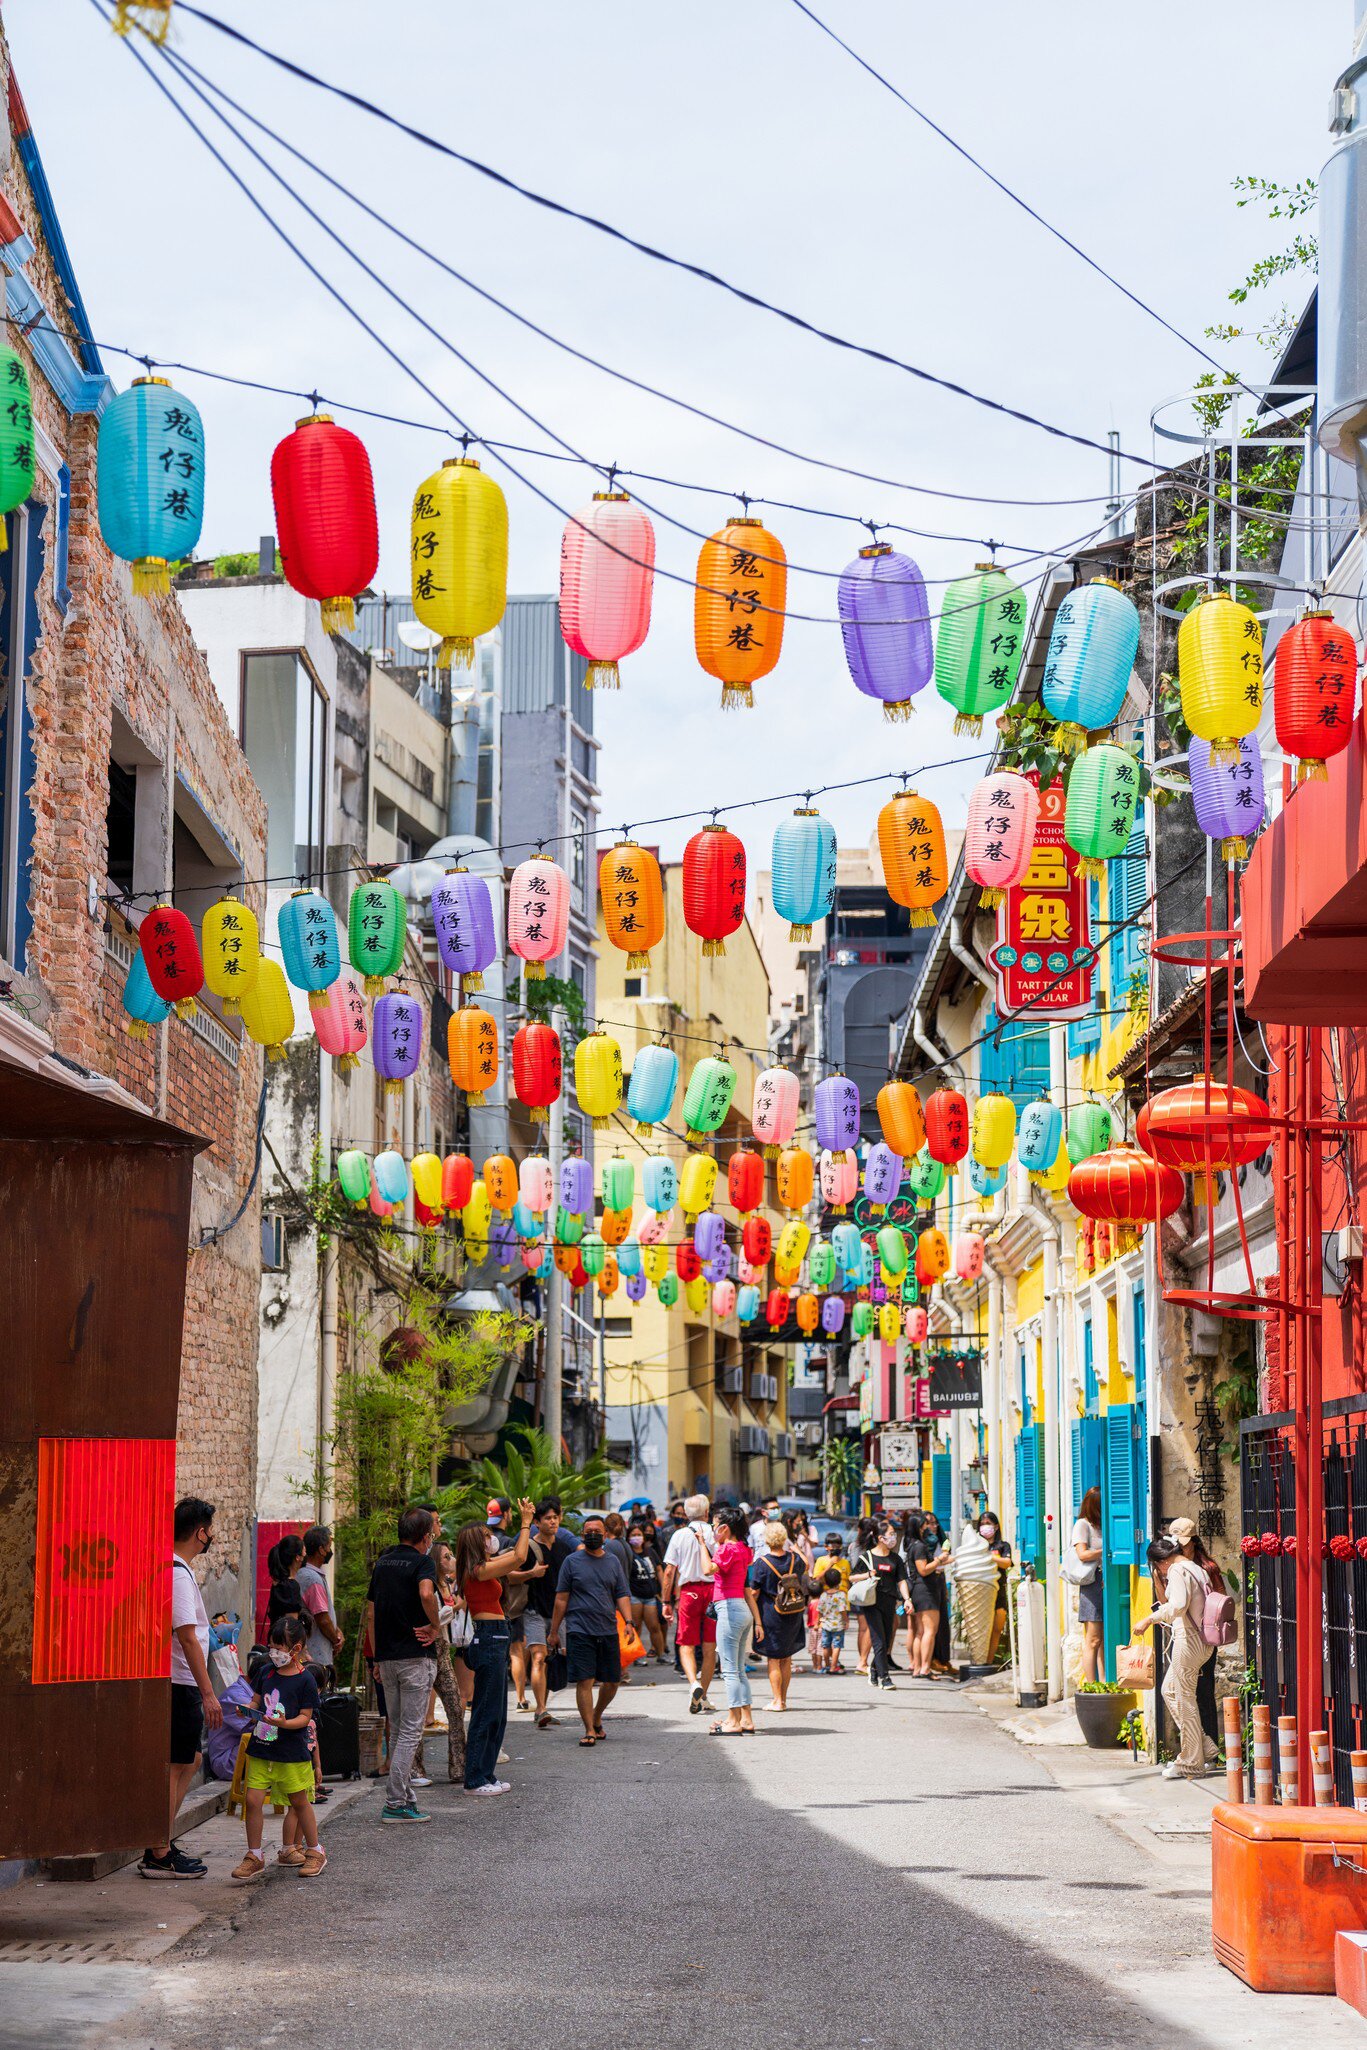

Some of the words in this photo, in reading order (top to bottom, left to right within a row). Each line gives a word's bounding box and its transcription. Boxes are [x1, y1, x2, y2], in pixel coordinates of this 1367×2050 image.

[6, 360, 33, 474] 鬼仔巷
[159, 407, 198, 521] 鬼仔巷
[412, 493, 447, 601] 鬼仔巷
[725, 552, 764, 652] 鬼仔巷
[985, 599, 1023, 690] 鬼仔巷
[1045, 602, 1076, 689] 鬼仔巷
[1241, 619, 1263, 708] 鬼仔巷
[1315, 639, 1349, 729] 鬼仔巷
[983, 789, 1015, 862] 鬼仔巷
[1111, 764, 1136, 837] 鬼仔巷
[907, 817, 941, 888] 鬼仔巷
[523, 876, 551, 943] 鬼仔巷
[615, 865, 644, 933] 鬼仔巷
[729, 851, 747, 922] 鬼仔巷
[153, 920, 186, 979] 鬼仔巷
[219, 914, 246, 976] 鬼仔巷
[305, 907, 335, 970] 鬼仔巷
[361, 892, 387, 953] 鬼仔巷
[436, 889, 471, 954] 鬼仔巷
[346, 979, 367, 1033] 鬼仔巷
[1017, 981, 1041, 990] TART
[391, 1006, 414, 1063] 鬼仔巷
[478, 1021, 497, 1076] 鬼仔巷
[707, 1075, 731, 1122] 鬼仔巷
[756, 1079, 776, 1129] 鬼仔巷
[843, 1086, 858, 1135] 鬼仔巷
[946, 1103, 965, 1151] 鬼仔巷
[1024, 1112, 1044, 1157] 鬼仔巷
[1193, 1398, 1227, 1503] 鬼仔巷
[1199, 1527, 1226, 1537] HONG
